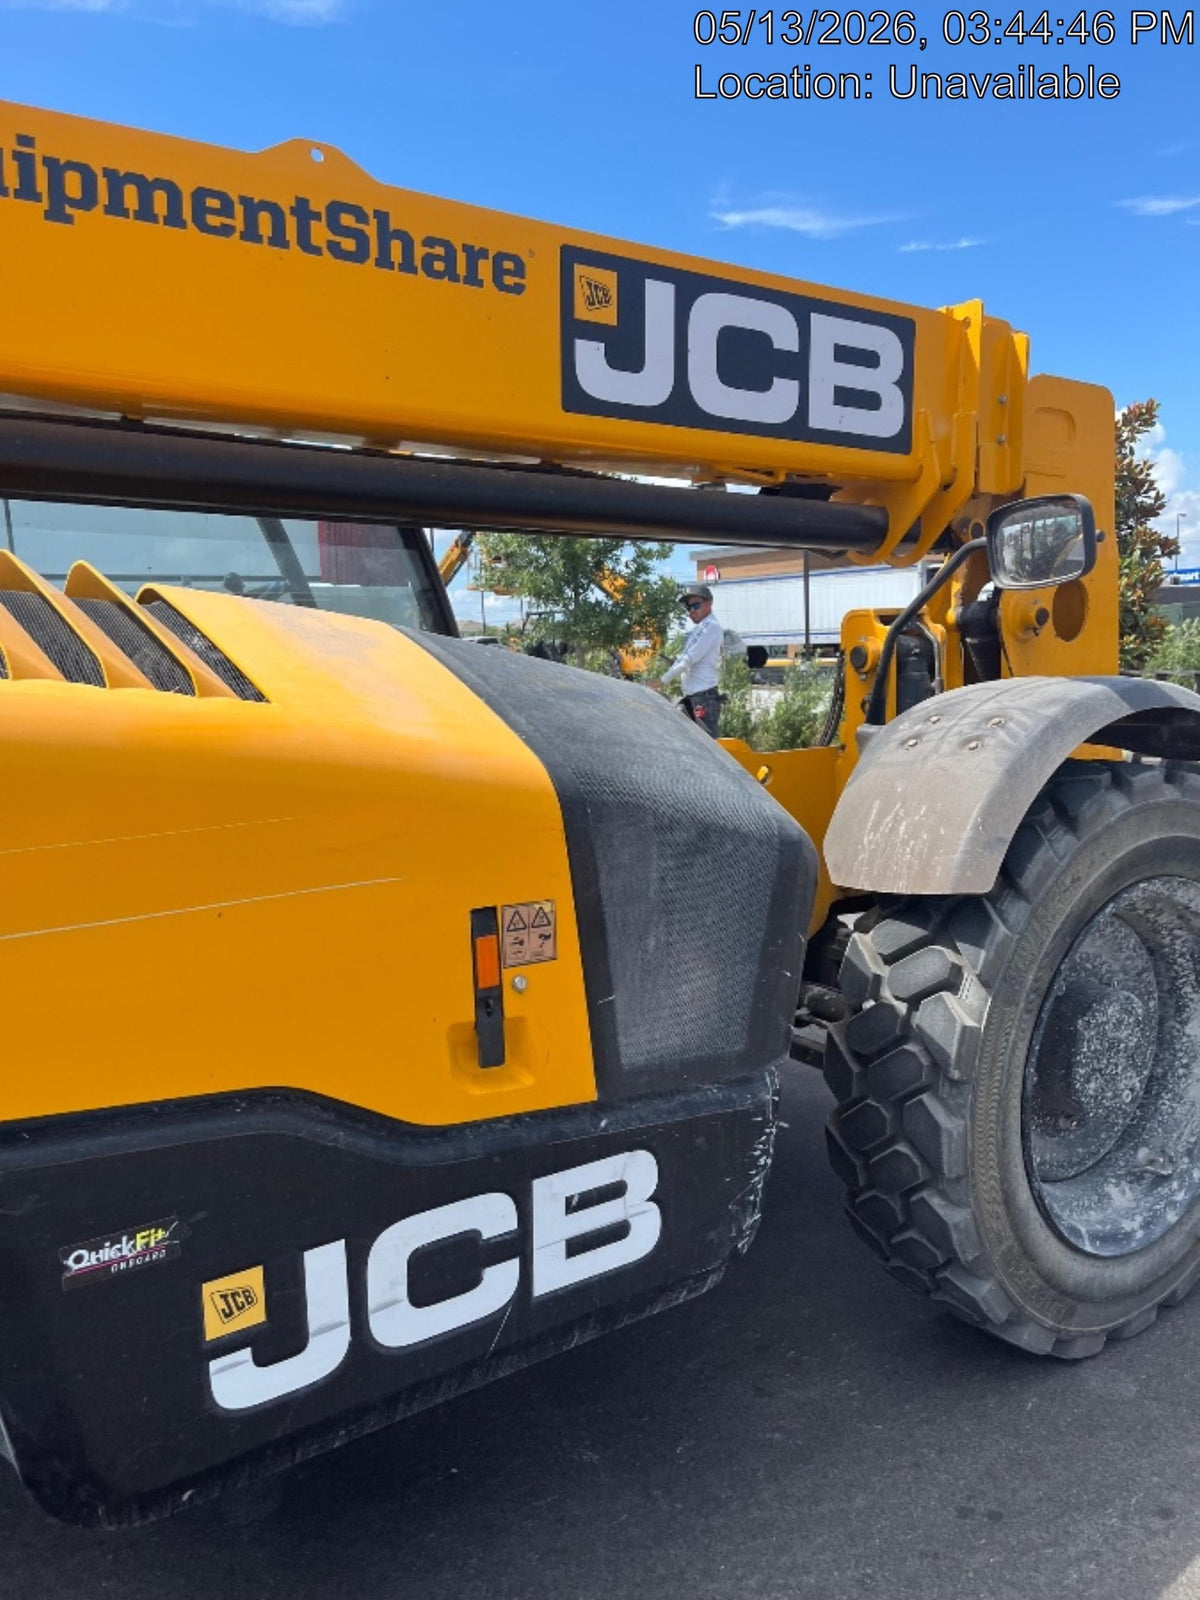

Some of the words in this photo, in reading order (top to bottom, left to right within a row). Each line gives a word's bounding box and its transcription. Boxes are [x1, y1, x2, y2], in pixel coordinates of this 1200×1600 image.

[0, 133, 526, 295] ipmentShare
[586, 281, 612, 306] JCB
[574, 278, 905, 439] JCB
[209, 1149, 662, 1411] JCB
[219, 1288, 254, 1319] JCB
